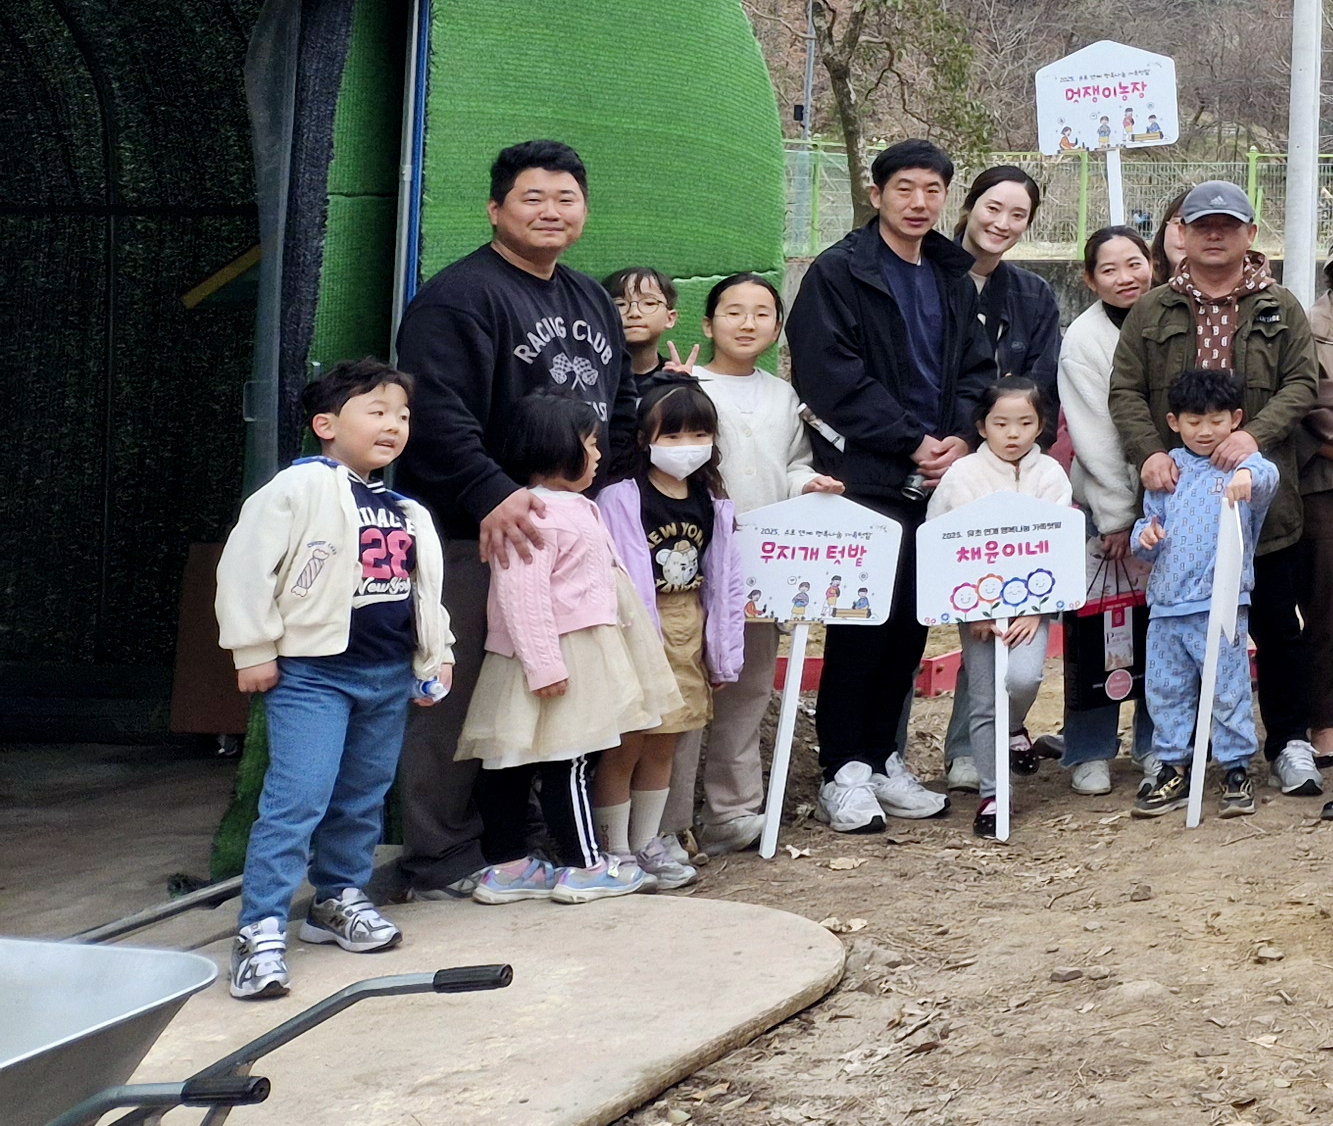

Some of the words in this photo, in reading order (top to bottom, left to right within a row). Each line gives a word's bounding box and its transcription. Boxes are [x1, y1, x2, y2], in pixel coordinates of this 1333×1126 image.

[1066, 81, 1147, 103] 멋쟁이농장
[572, 320, 612, 365] CLUB
[360, 528, 413, 579] 28
[760, 541, 819, 564] 무지개
[826, 544, 867, 567] 텃밭
[956, 540, 1049, 564] 채윤이네
